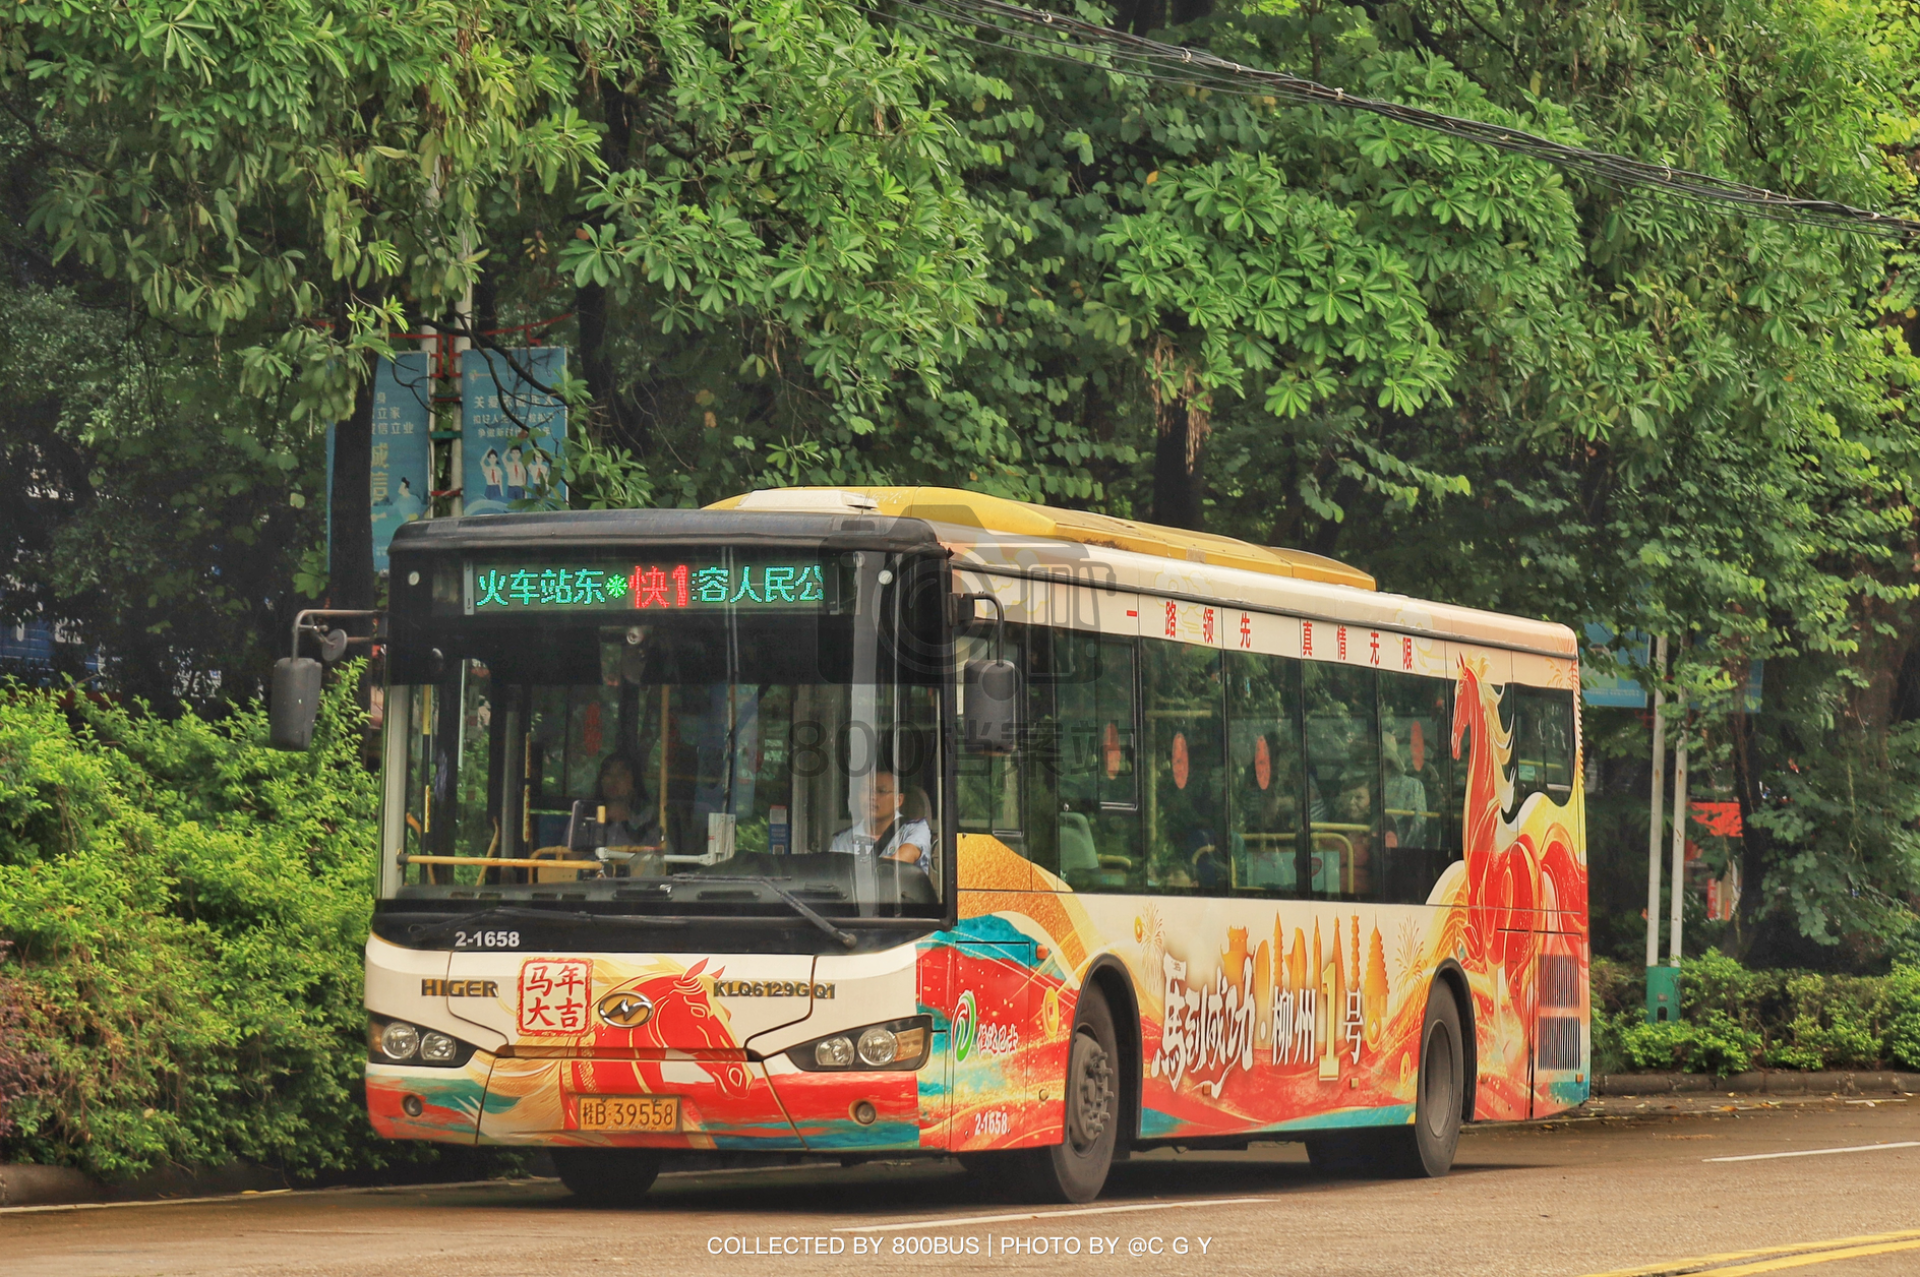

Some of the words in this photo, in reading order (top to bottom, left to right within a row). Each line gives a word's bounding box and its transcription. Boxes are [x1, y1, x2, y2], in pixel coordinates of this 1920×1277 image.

[372, 406, 401, 420] 立家
[476, 567, 605, 607] 火车站东
[628, 564, 689, 609] 快1
[691, 564, 824, 604] 容人民公
[1126, 600, 1251, 649] 一路领先
[1302, 621, 1413, 670] 真情无限
[454, 930, 520, 948] 2-1658
[421, 978, 499, 998] HIGER
[525, 965, 584, 997] 马年
[713, 980, 836, 999] KLQ6129GQ1
[525, 997, 584, 1029] 大吉
[974, 1111, 1009, 1136] 2-1658
